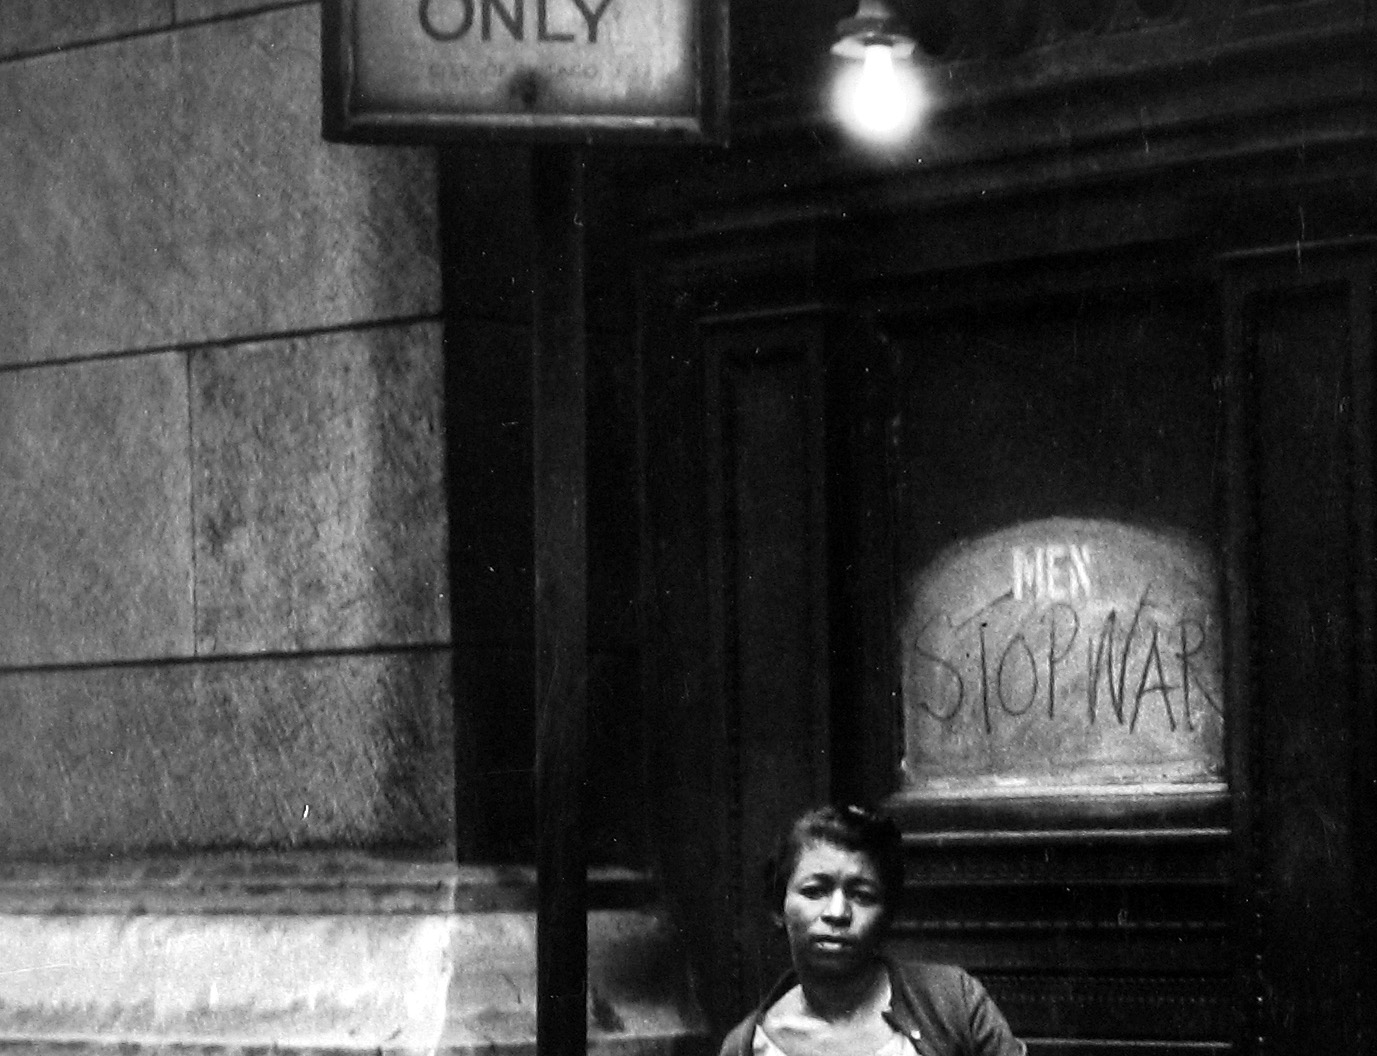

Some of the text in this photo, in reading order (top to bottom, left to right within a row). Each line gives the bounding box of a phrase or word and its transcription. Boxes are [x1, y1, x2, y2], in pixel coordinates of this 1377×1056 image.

[418, 0, 611, 43] ONLY
[1011, 544, 1092, 600] MEN
[914, 582, 1224, 734] STOP WAR
